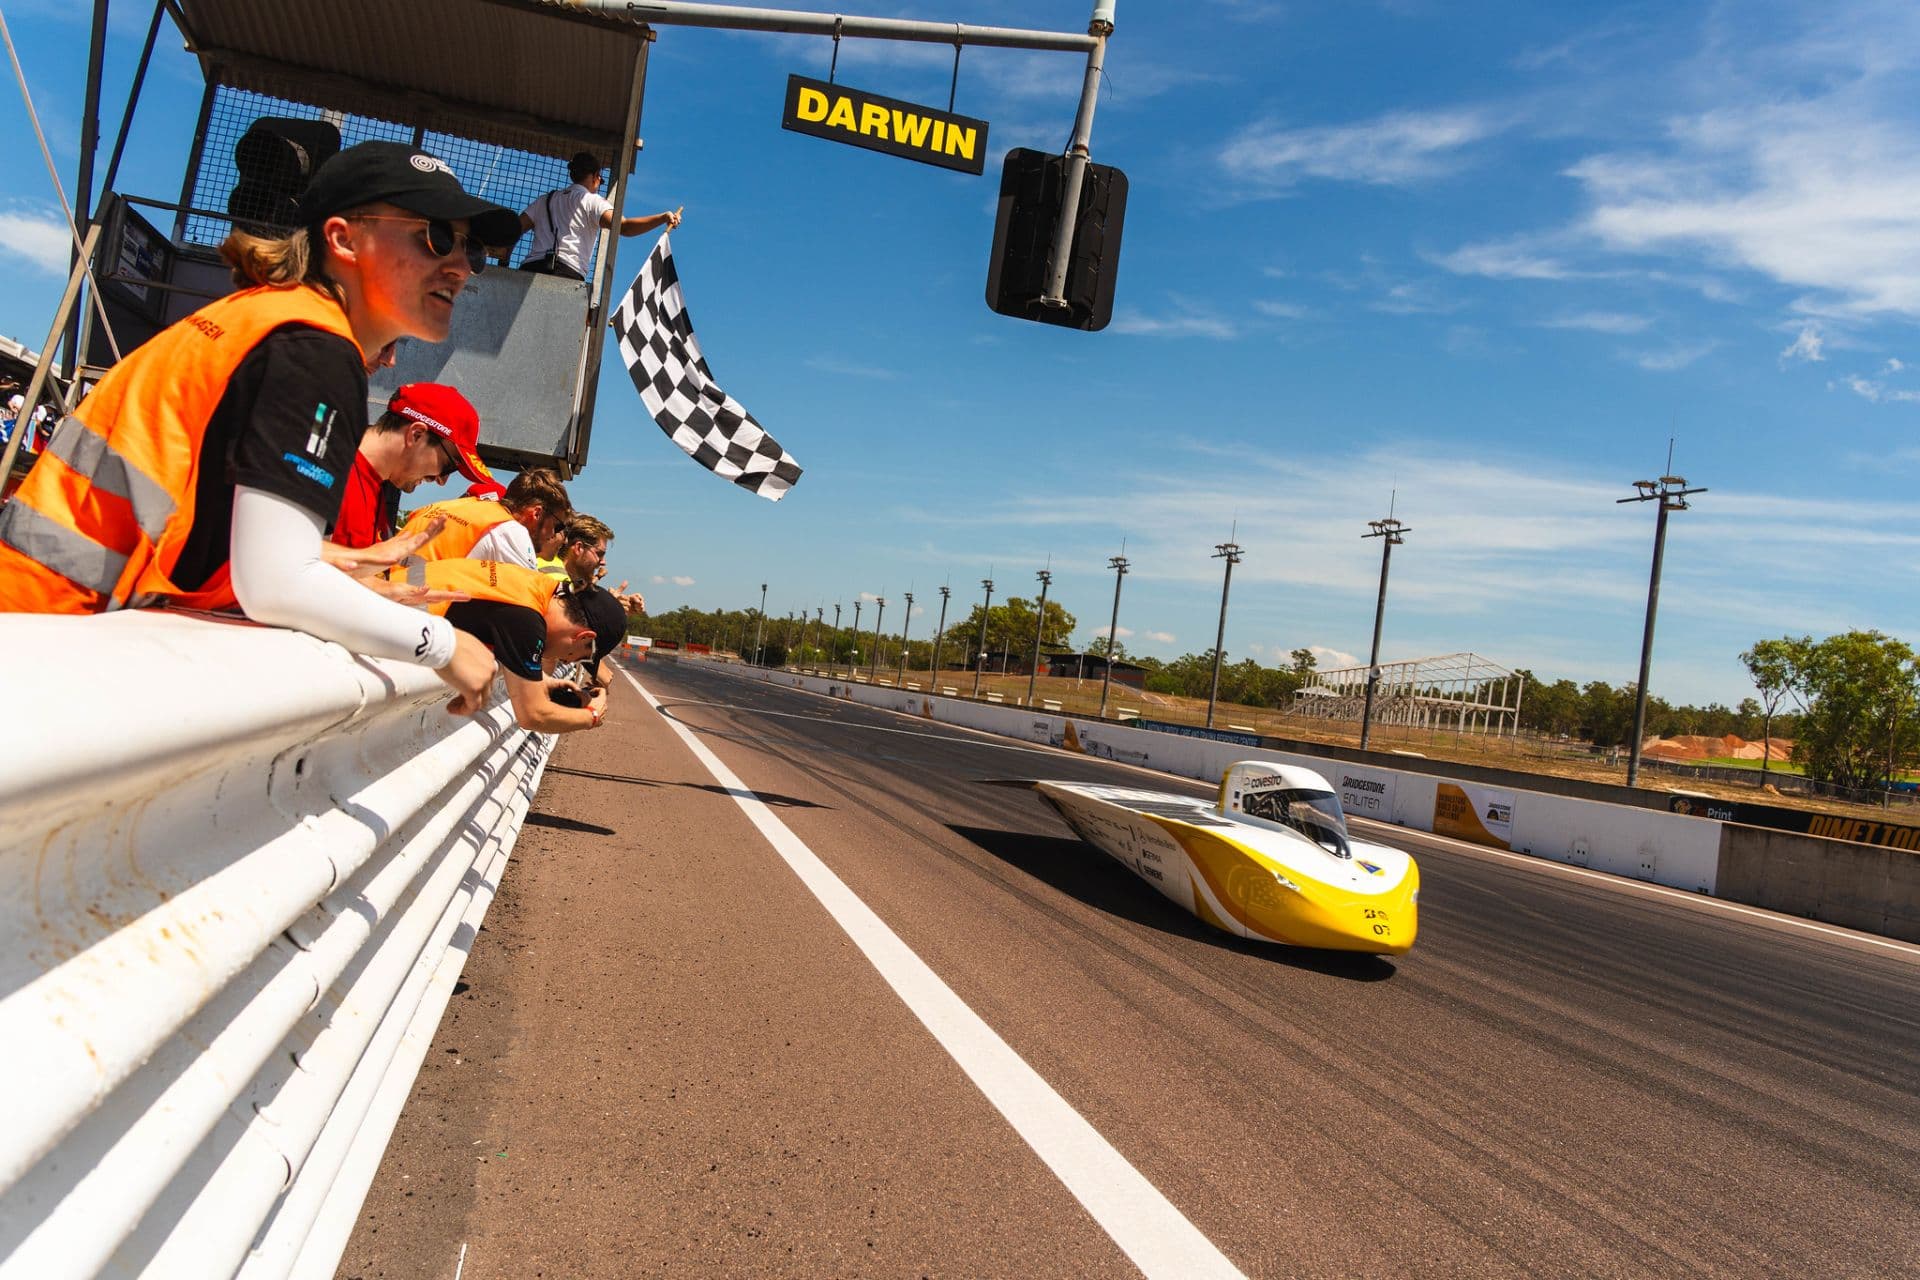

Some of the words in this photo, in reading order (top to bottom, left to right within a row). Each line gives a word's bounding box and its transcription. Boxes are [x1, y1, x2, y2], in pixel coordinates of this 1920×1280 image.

[797, 87, 976, 160] DARWIN
[401, 407, 453, 436] BRIDGESTONE
[1251, 775, 1282, 788] covestro
[1342, 776, 1386, 794] BRIDGESTONE
[1707, 807, 1733, 821] Print
[1807, 815, 1880, 845] DIMET
